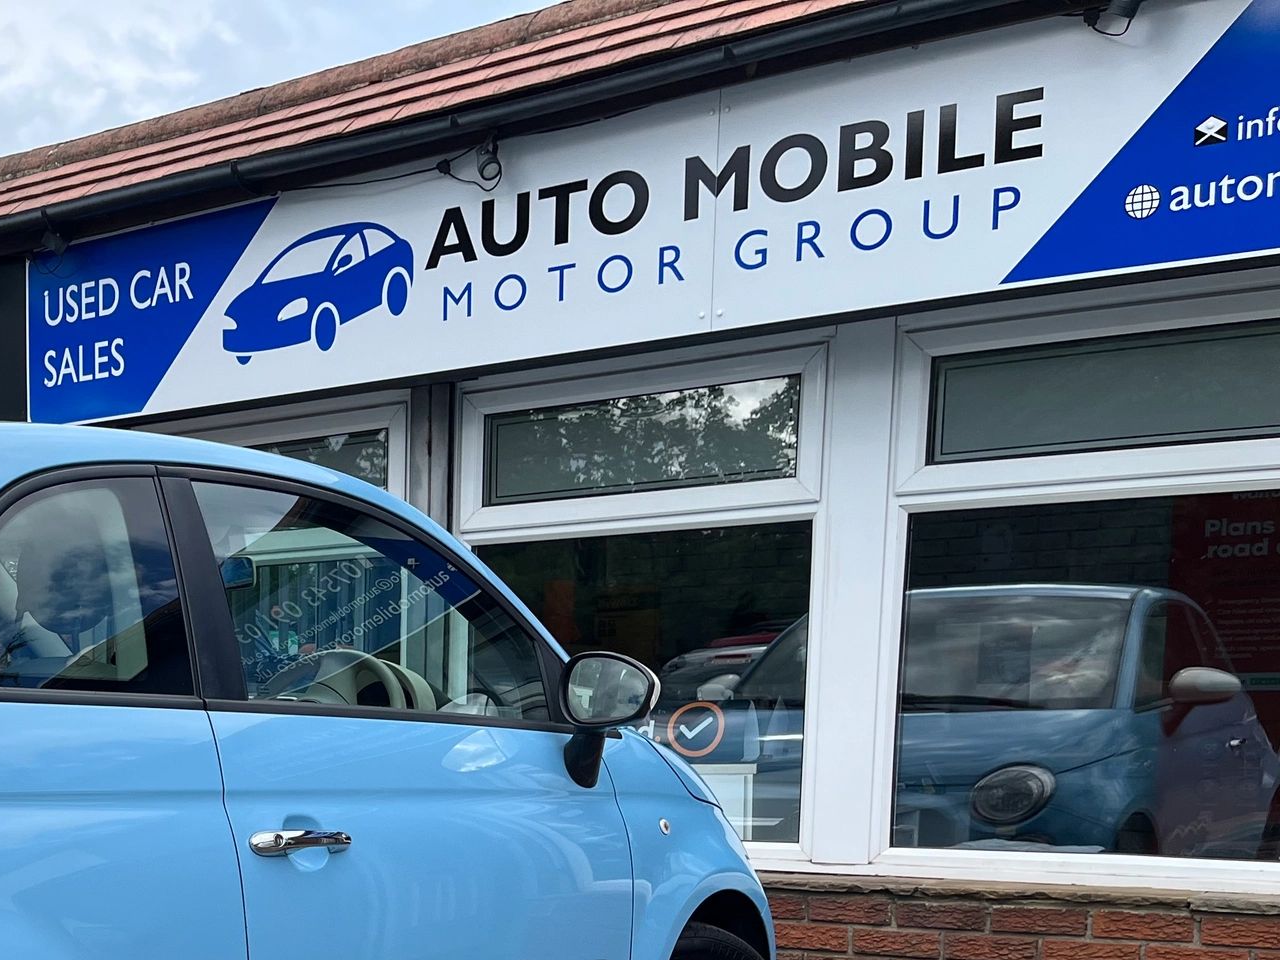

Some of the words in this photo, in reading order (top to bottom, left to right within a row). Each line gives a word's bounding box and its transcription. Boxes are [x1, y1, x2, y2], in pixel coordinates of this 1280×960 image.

[1237, 106, 1280, 141] inf
[425, 170, 650, 271] AUTO
[683, 86, 1045, 222] MOBILE
[442, 245, 685, 321] MOTOR
[734, 185, 1021, 271] GROUP
[43, 278, 119, 327] USED
[129, 261, 194, 310] CAR
[43, 337, 125, 388] SALES
[1205, 518, 1275, 537] Plans
[1207, 538, 1269, 558] road
